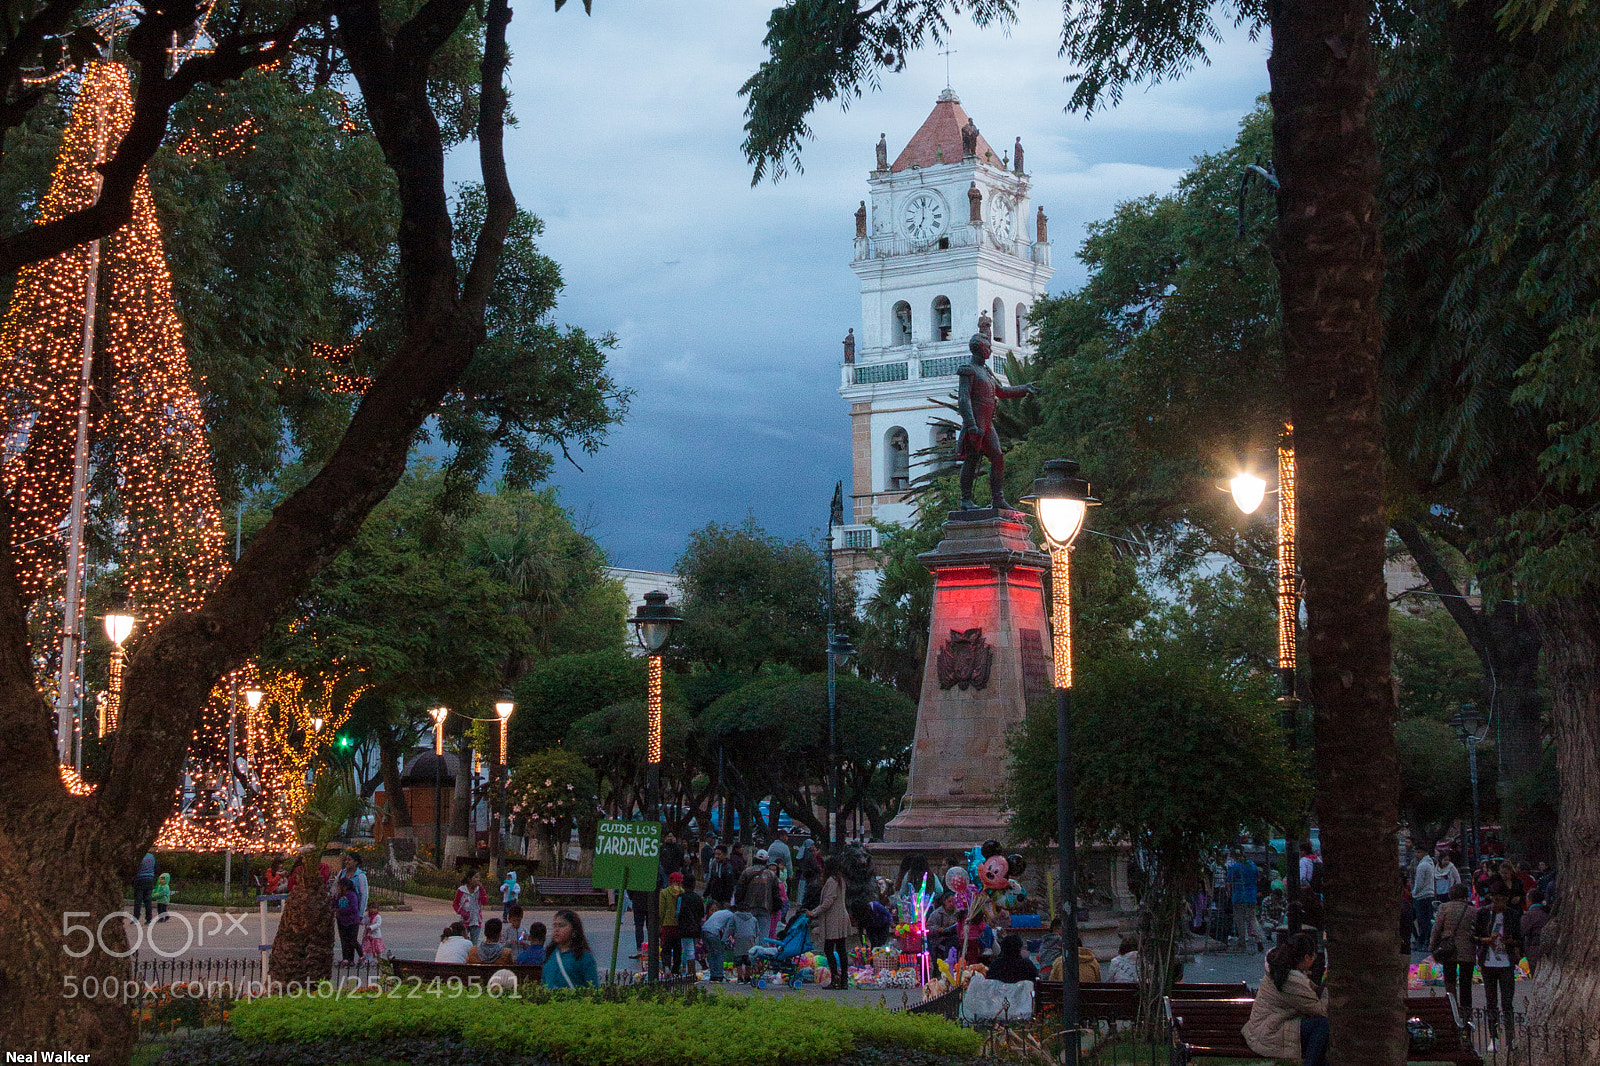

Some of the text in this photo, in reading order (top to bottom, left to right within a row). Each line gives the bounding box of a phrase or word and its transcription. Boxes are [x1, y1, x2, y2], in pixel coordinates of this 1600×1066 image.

[600, 823, 657, 834] CUIDE LOS
[595, 835, 658, 857] JARDINES
